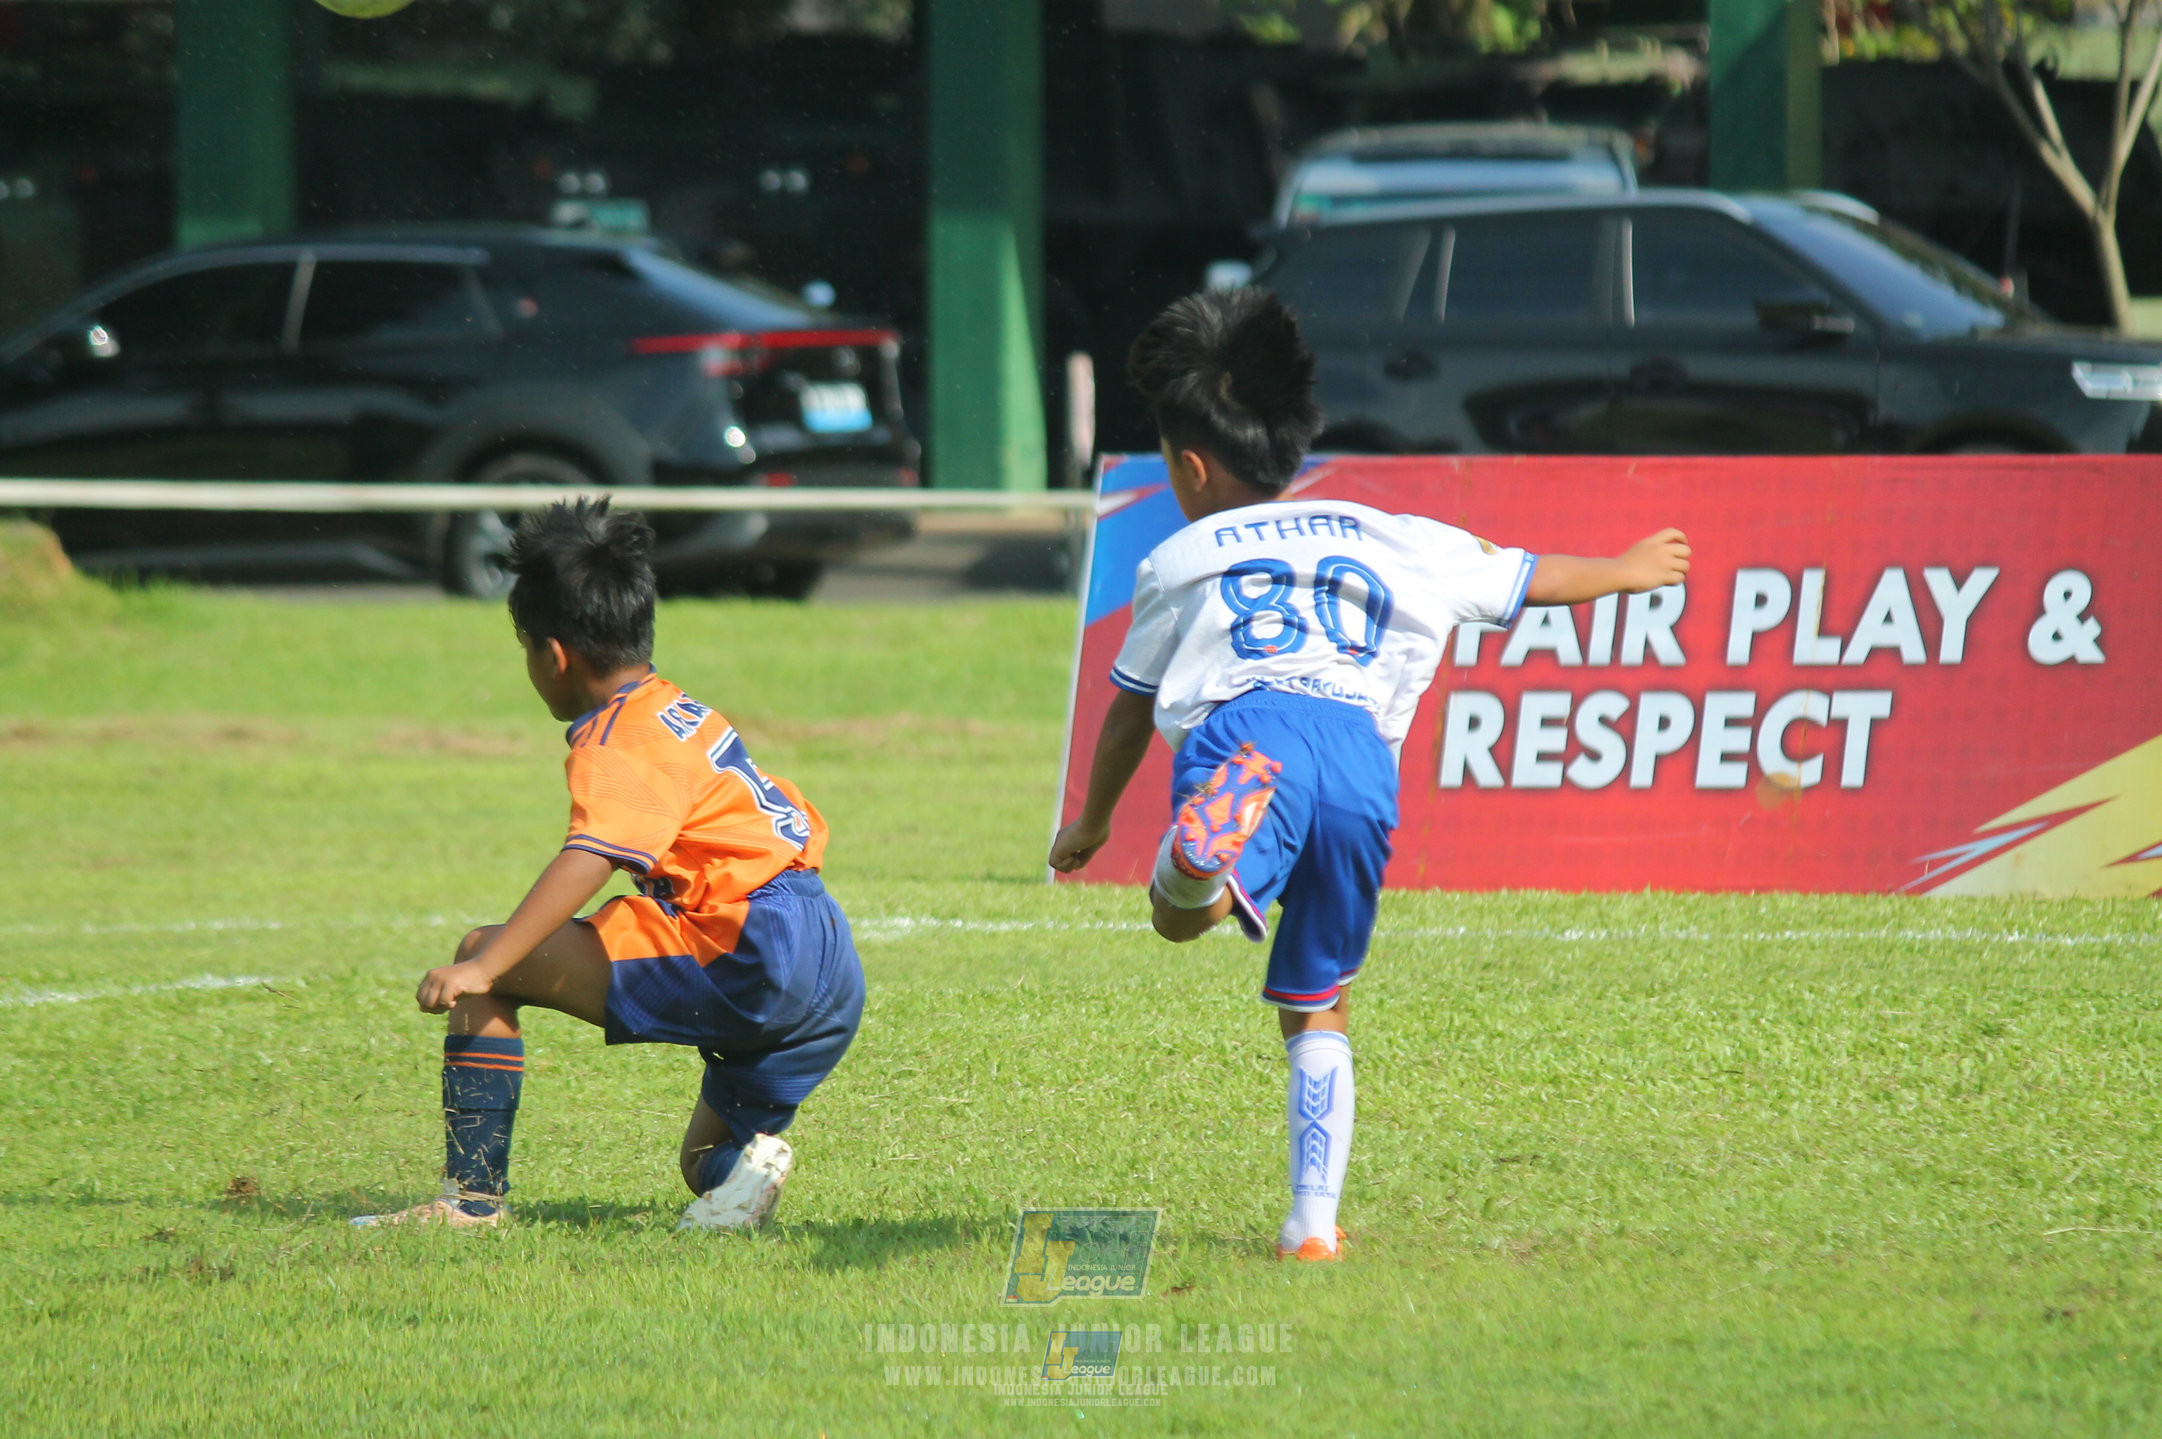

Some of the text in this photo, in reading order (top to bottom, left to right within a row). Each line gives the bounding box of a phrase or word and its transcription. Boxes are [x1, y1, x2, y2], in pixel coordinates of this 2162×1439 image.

[1214, 515, 1363, 546] ATHAR
[1220, 555, 1394, 667] 80
[1726, 567, 1999, 665] PLAY
[2027, 570, 2105, 664] &
[1439, 691, 1892, 788] RESPECT
